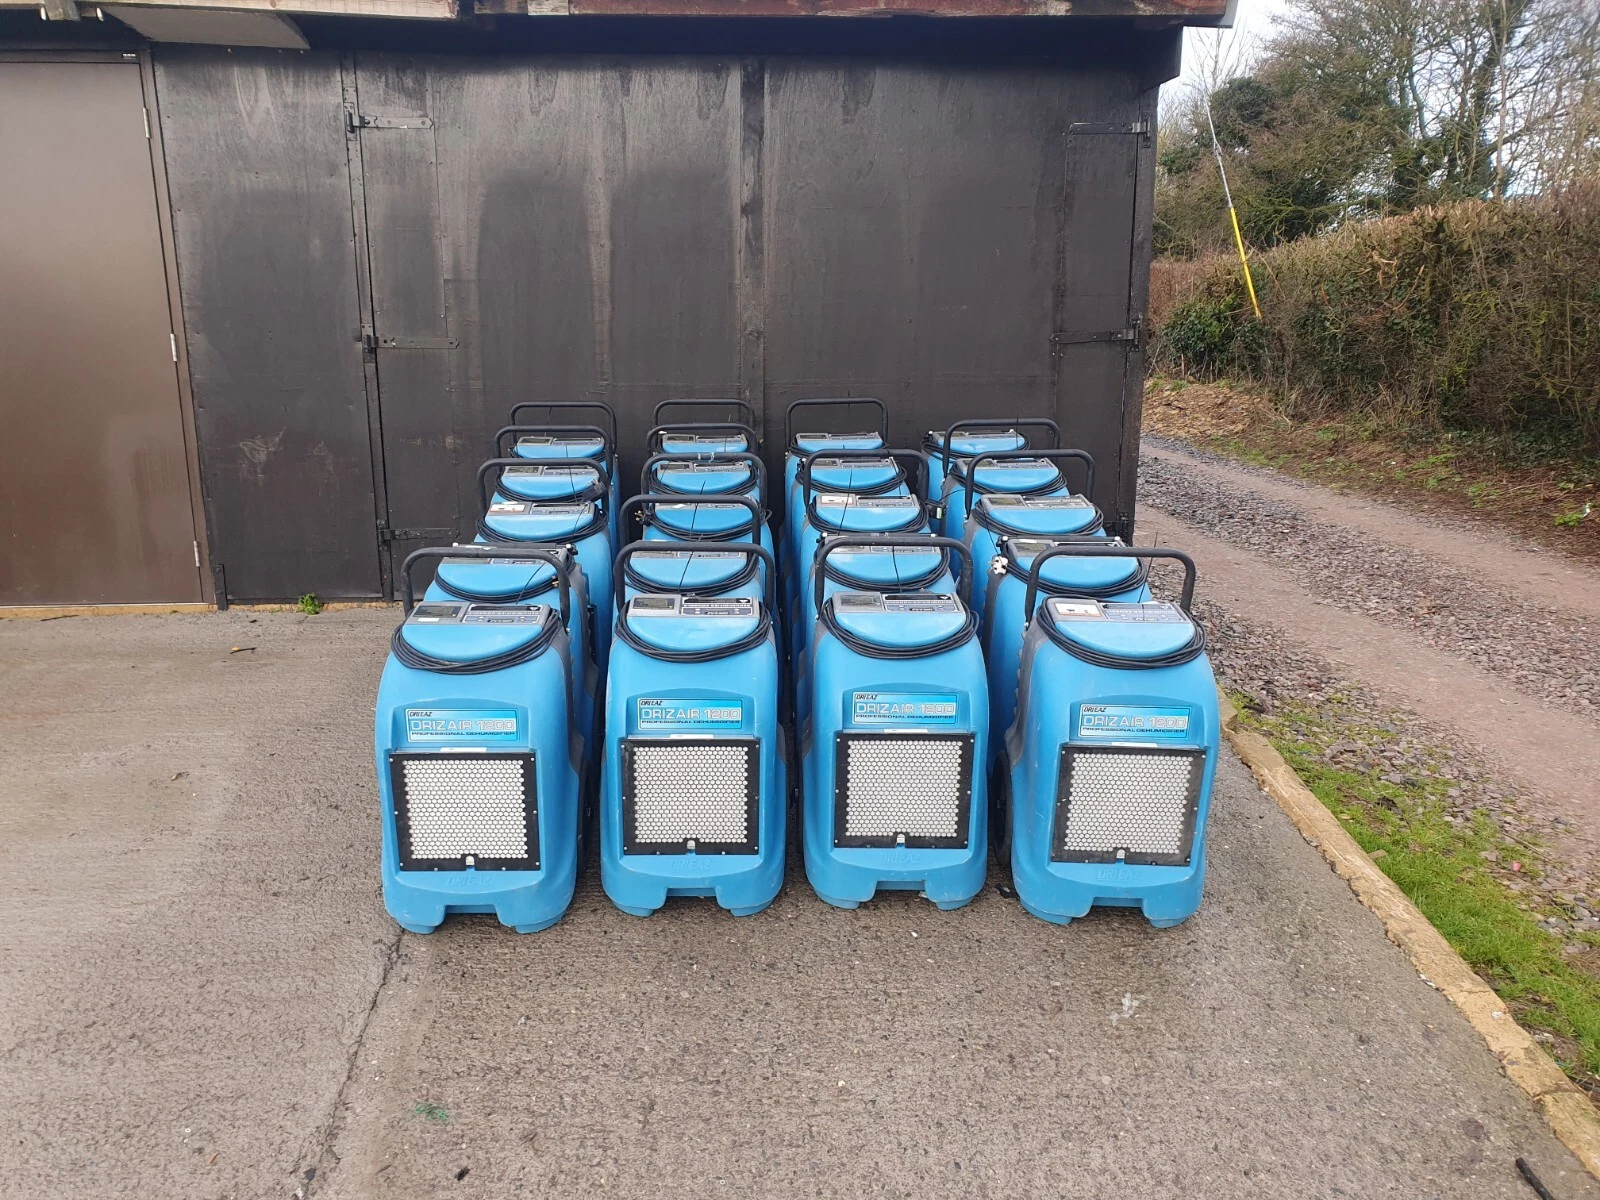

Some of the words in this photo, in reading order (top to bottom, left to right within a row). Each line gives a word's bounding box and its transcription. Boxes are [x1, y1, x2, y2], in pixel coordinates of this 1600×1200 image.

[642, 708, 700, 720] DRIZAIR
[703, 708, 740, 720] 1200
[856, 702, 914, 714] DRIZAIR
[917, 703, 955, 714] 1200
[411, 719, 472, 731] DRIZAIR
[476, 719, 514, 731] 1200
[1083, 715, 1144, 727] DRIZAIR
[1147, 716, 1187, 728] 1200
